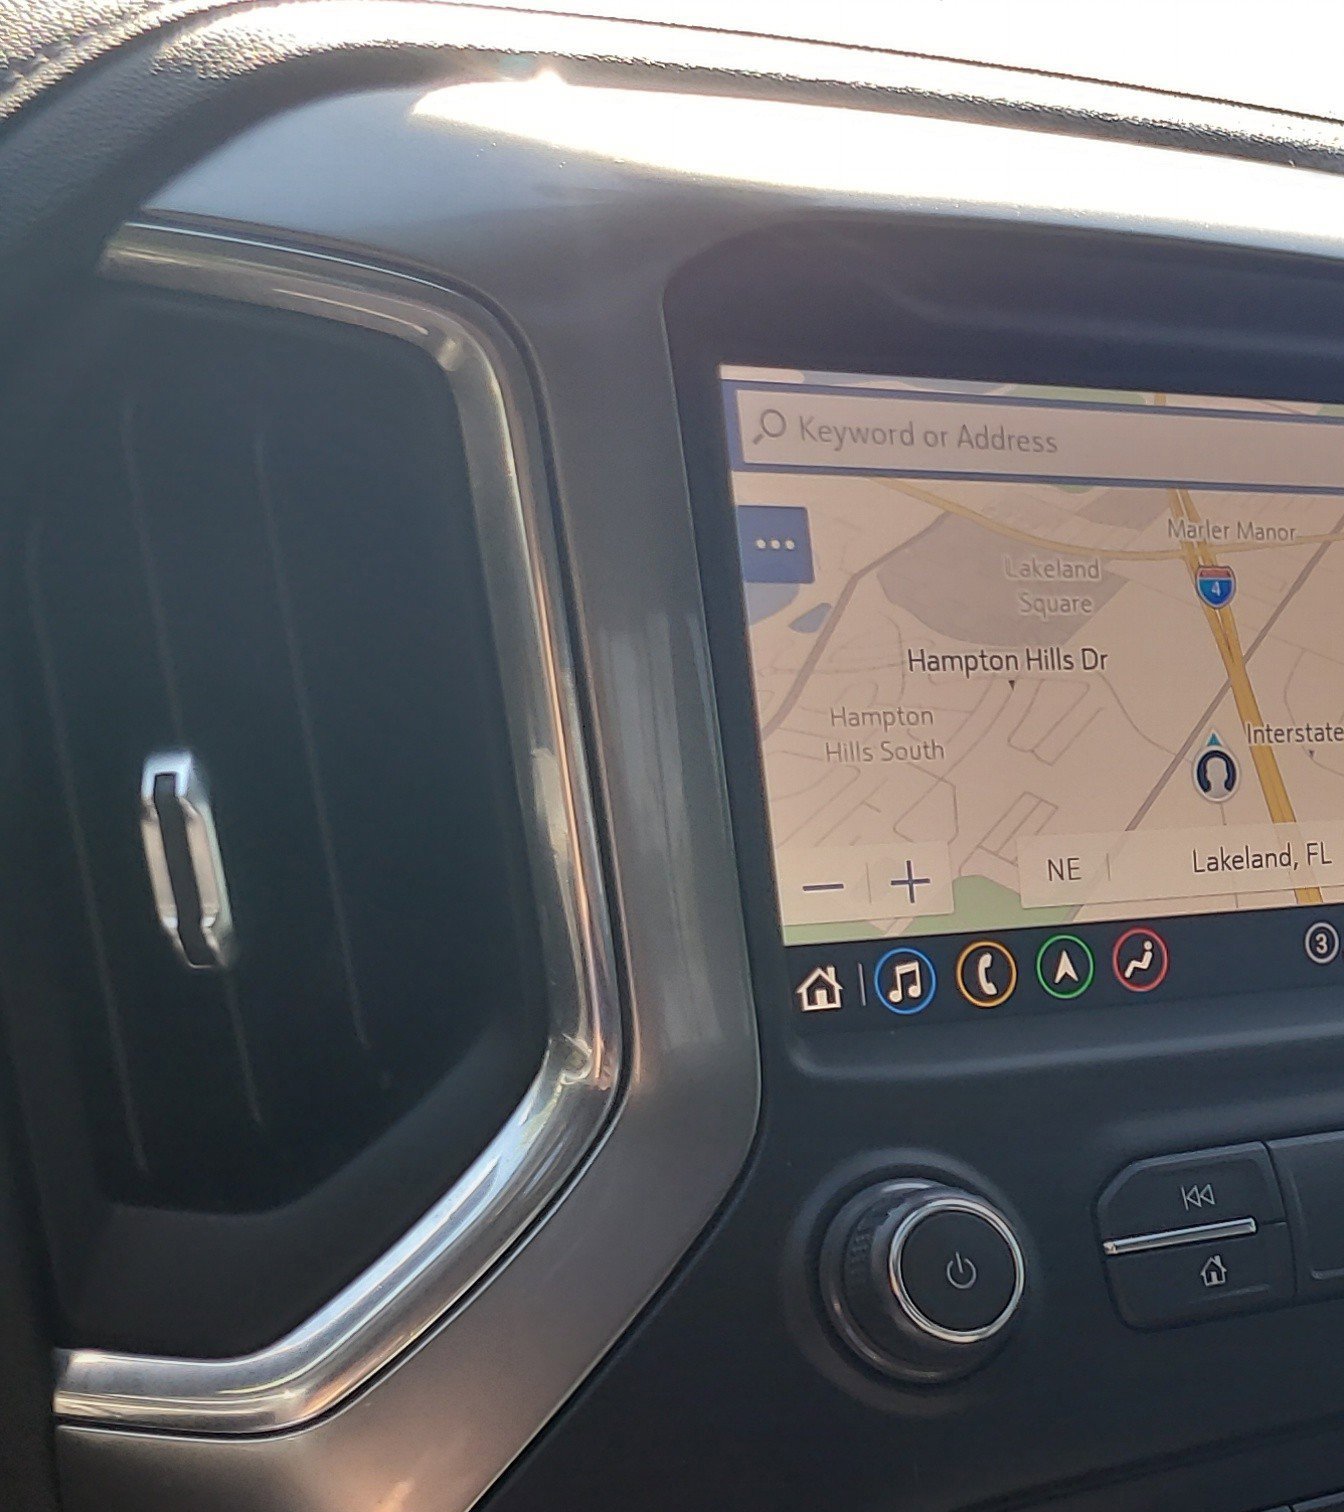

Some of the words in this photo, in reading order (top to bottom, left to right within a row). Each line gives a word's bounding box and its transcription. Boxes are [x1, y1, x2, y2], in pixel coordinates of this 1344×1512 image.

[798, 415, 915, 450] Keyword
[923, 430, 949, 449] or
[956, 424, 1059, 454] Address
[1167, 518, 1230, 541] Marler
[1236, 521, 1298, 542] Manor
[1004, 556, 1100, 580] Lakeland
[1210, 580, 1222, 597] 4
[1018, 591, 1093, 619] Square
[907, 648, 1020, 679] Hampton
[1025, 648, 1075, 671] Hills
[1080, 648, 1109, 671] Dr
[829, 706, 935, 733] Hampton
[1245, 722, 1344, 745] Interstate
[825, 741, 873, 763] Hills
[880, 740, 946, 763] South
[1046, 858, 1082, 882] NE
[1192, 844, 1300, 875] Lakeland,
[1306, 842, 1333, 866] FL
[1315, 933, 1329, 955] 3
